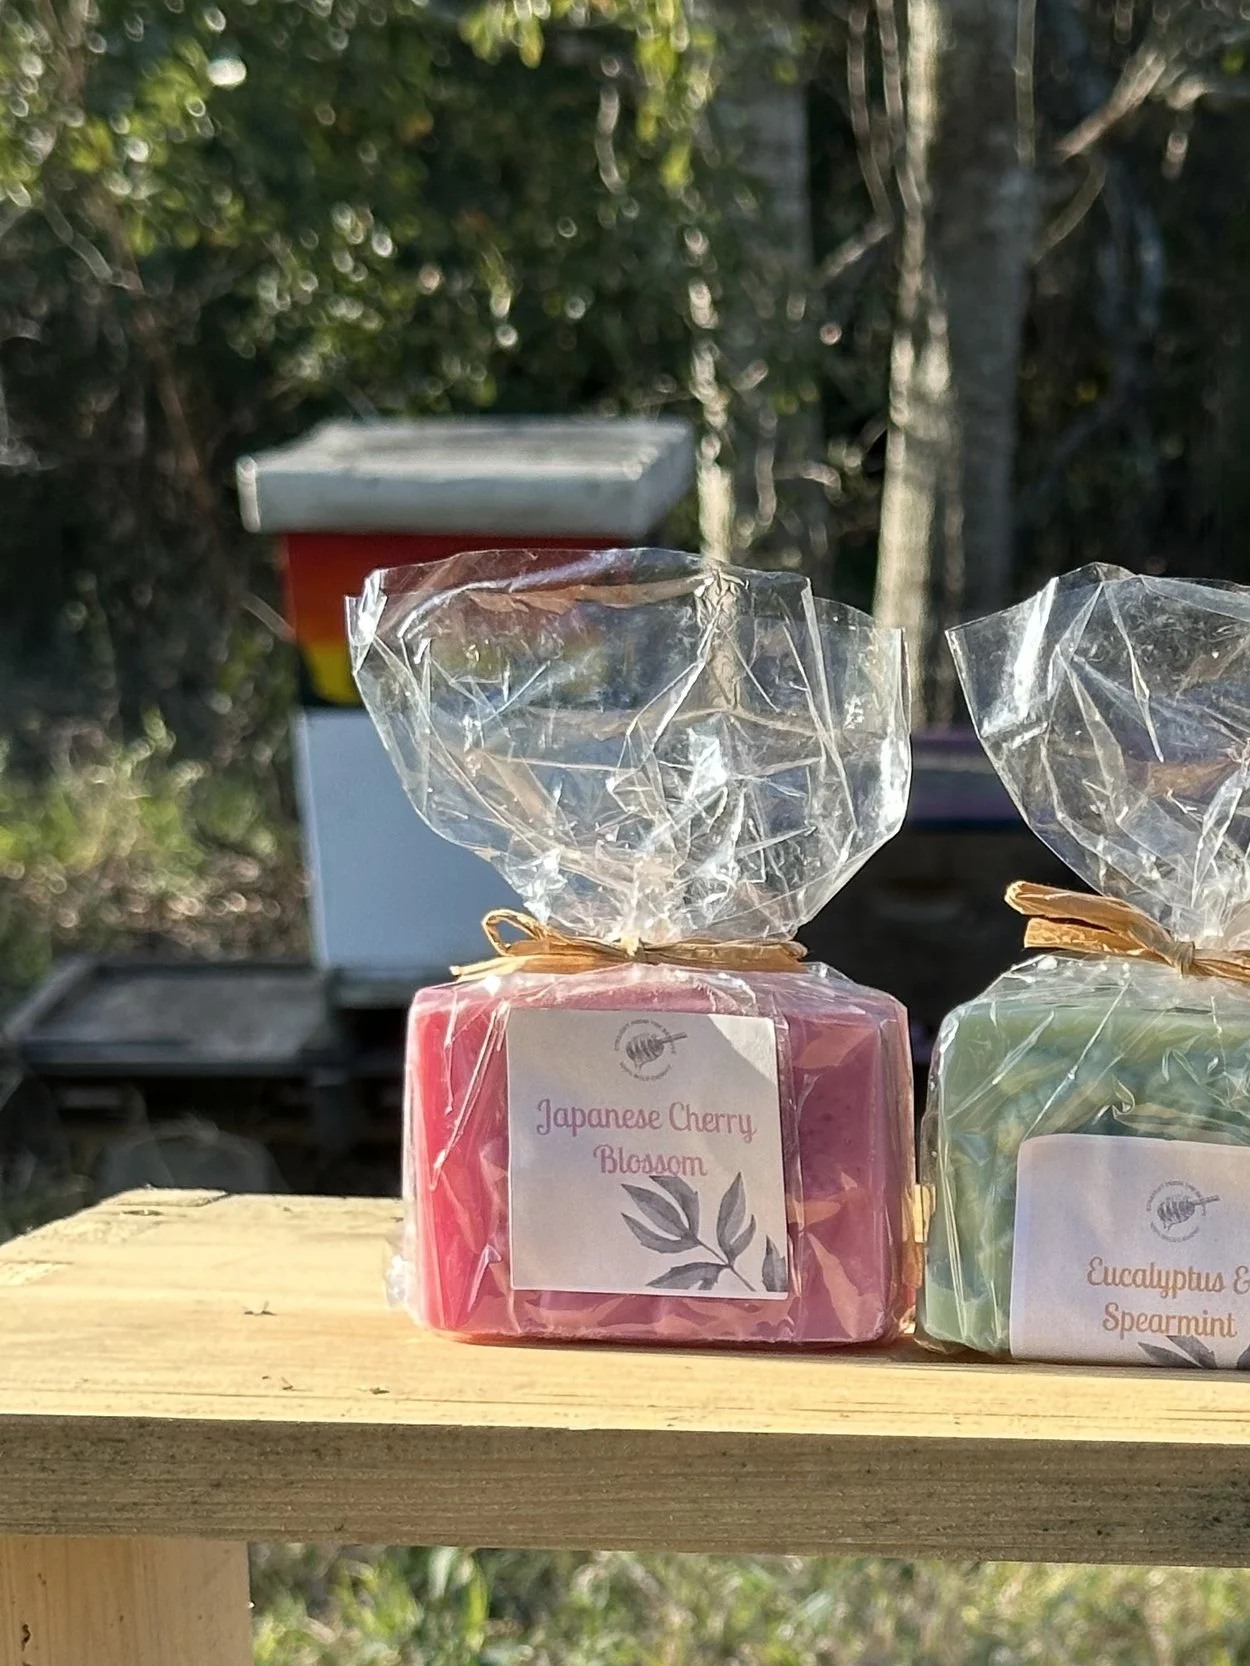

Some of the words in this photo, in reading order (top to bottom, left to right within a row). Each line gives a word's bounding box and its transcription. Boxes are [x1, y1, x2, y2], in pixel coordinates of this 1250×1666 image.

[536, 1098, 664, 1137] Japanese
[669, 1101, 757, 1144] Cherry
[593, 1143, 708, 1177] Blossom
[1087, 1256, 1226, 1299] Eucalyptus
[1102, 1301, 1238, 1340] Spearmint
